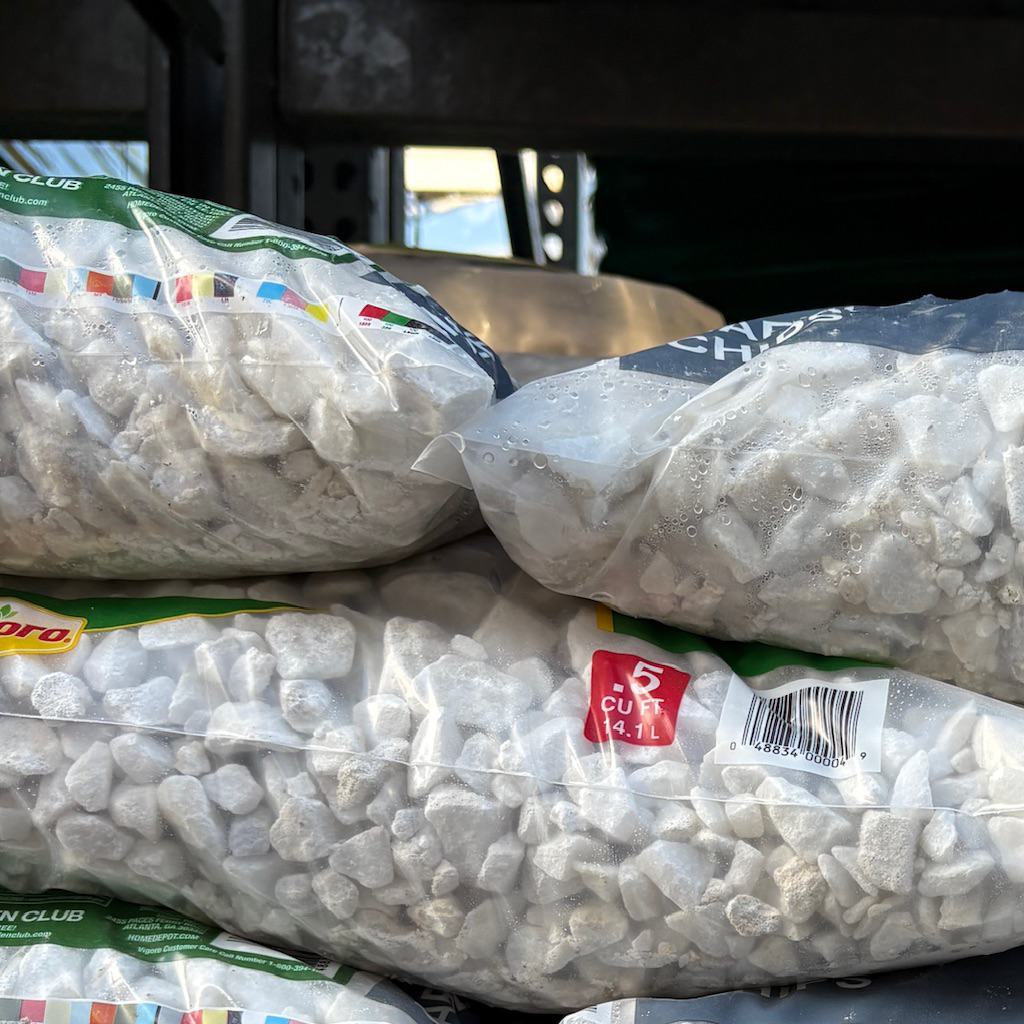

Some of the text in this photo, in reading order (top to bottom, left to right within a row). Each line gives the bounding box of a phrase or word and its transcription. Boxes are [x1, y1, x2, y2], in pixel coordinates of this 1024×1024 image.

[13, 174, 84, 190] CLUB
[668, 307, 843, 362] CHPS
[613, 661, 664, 695] .5
[601, 696, 664, 716] CU FT
[602, 719, 660, 739] 14.1 L
[754, 742, 798, 759] 48834
[805, 753, 846, 768] 00004
[21, 909, 85, 923] CLUB
[162, 944, 198, 953] Customer
[235, 953, 268, 965] Number
